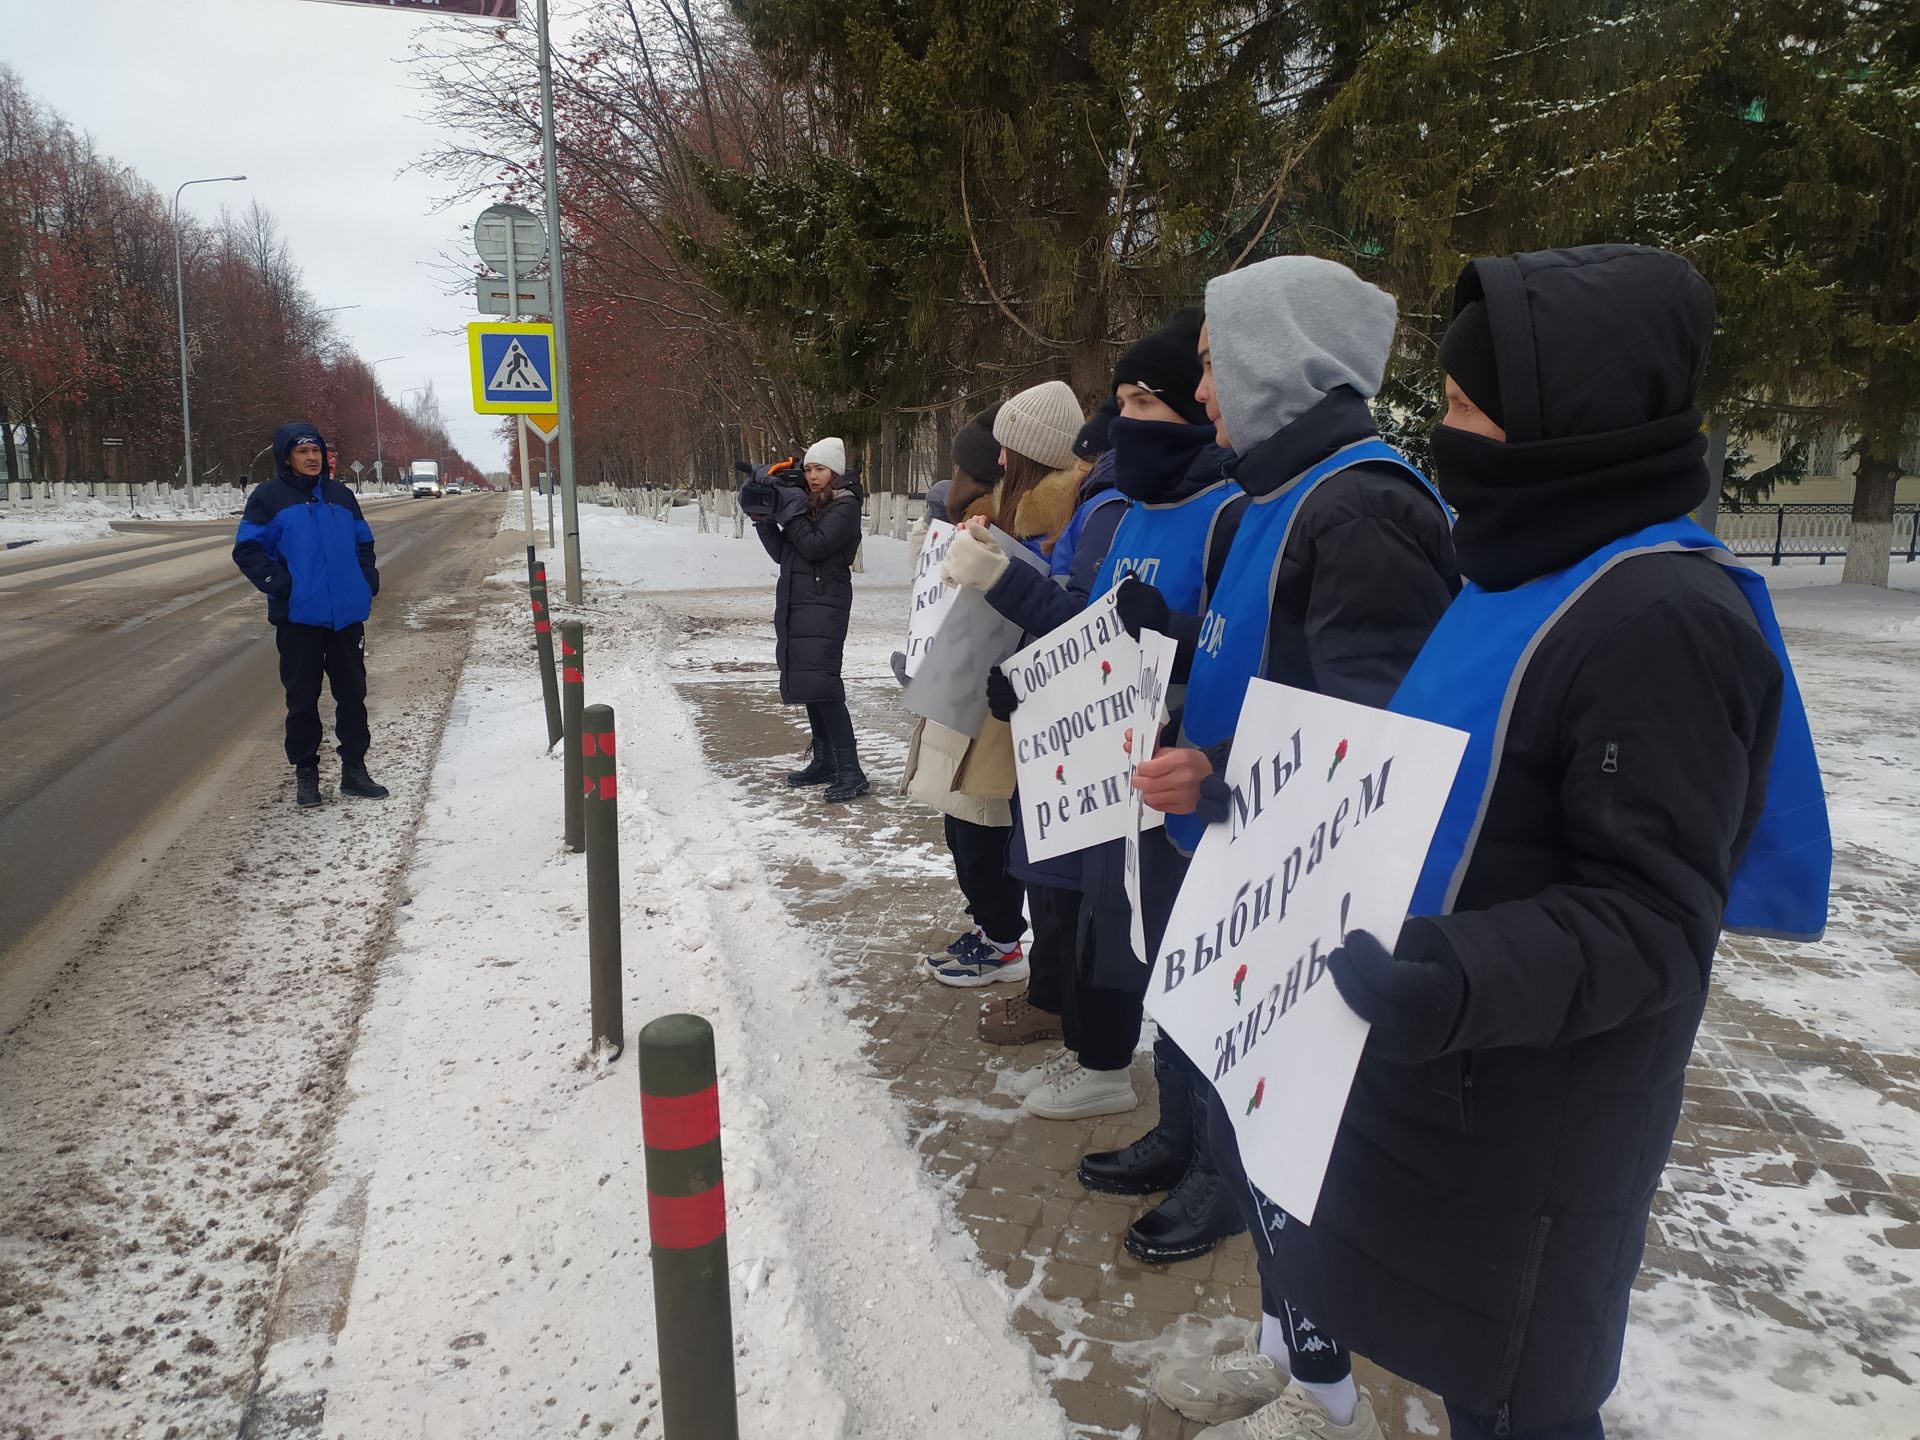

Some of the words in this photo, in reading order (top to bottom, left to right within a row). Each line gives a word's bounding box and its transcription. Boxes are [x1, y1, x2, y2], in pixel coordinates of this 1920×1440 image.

[1008, 593, 1125, 704] Соблюдай
[1017, 685, 1136, 764] скоростно
[1229, 727, 1303, 846] Мы
[1162, 755, 1395, 995] выбираем
